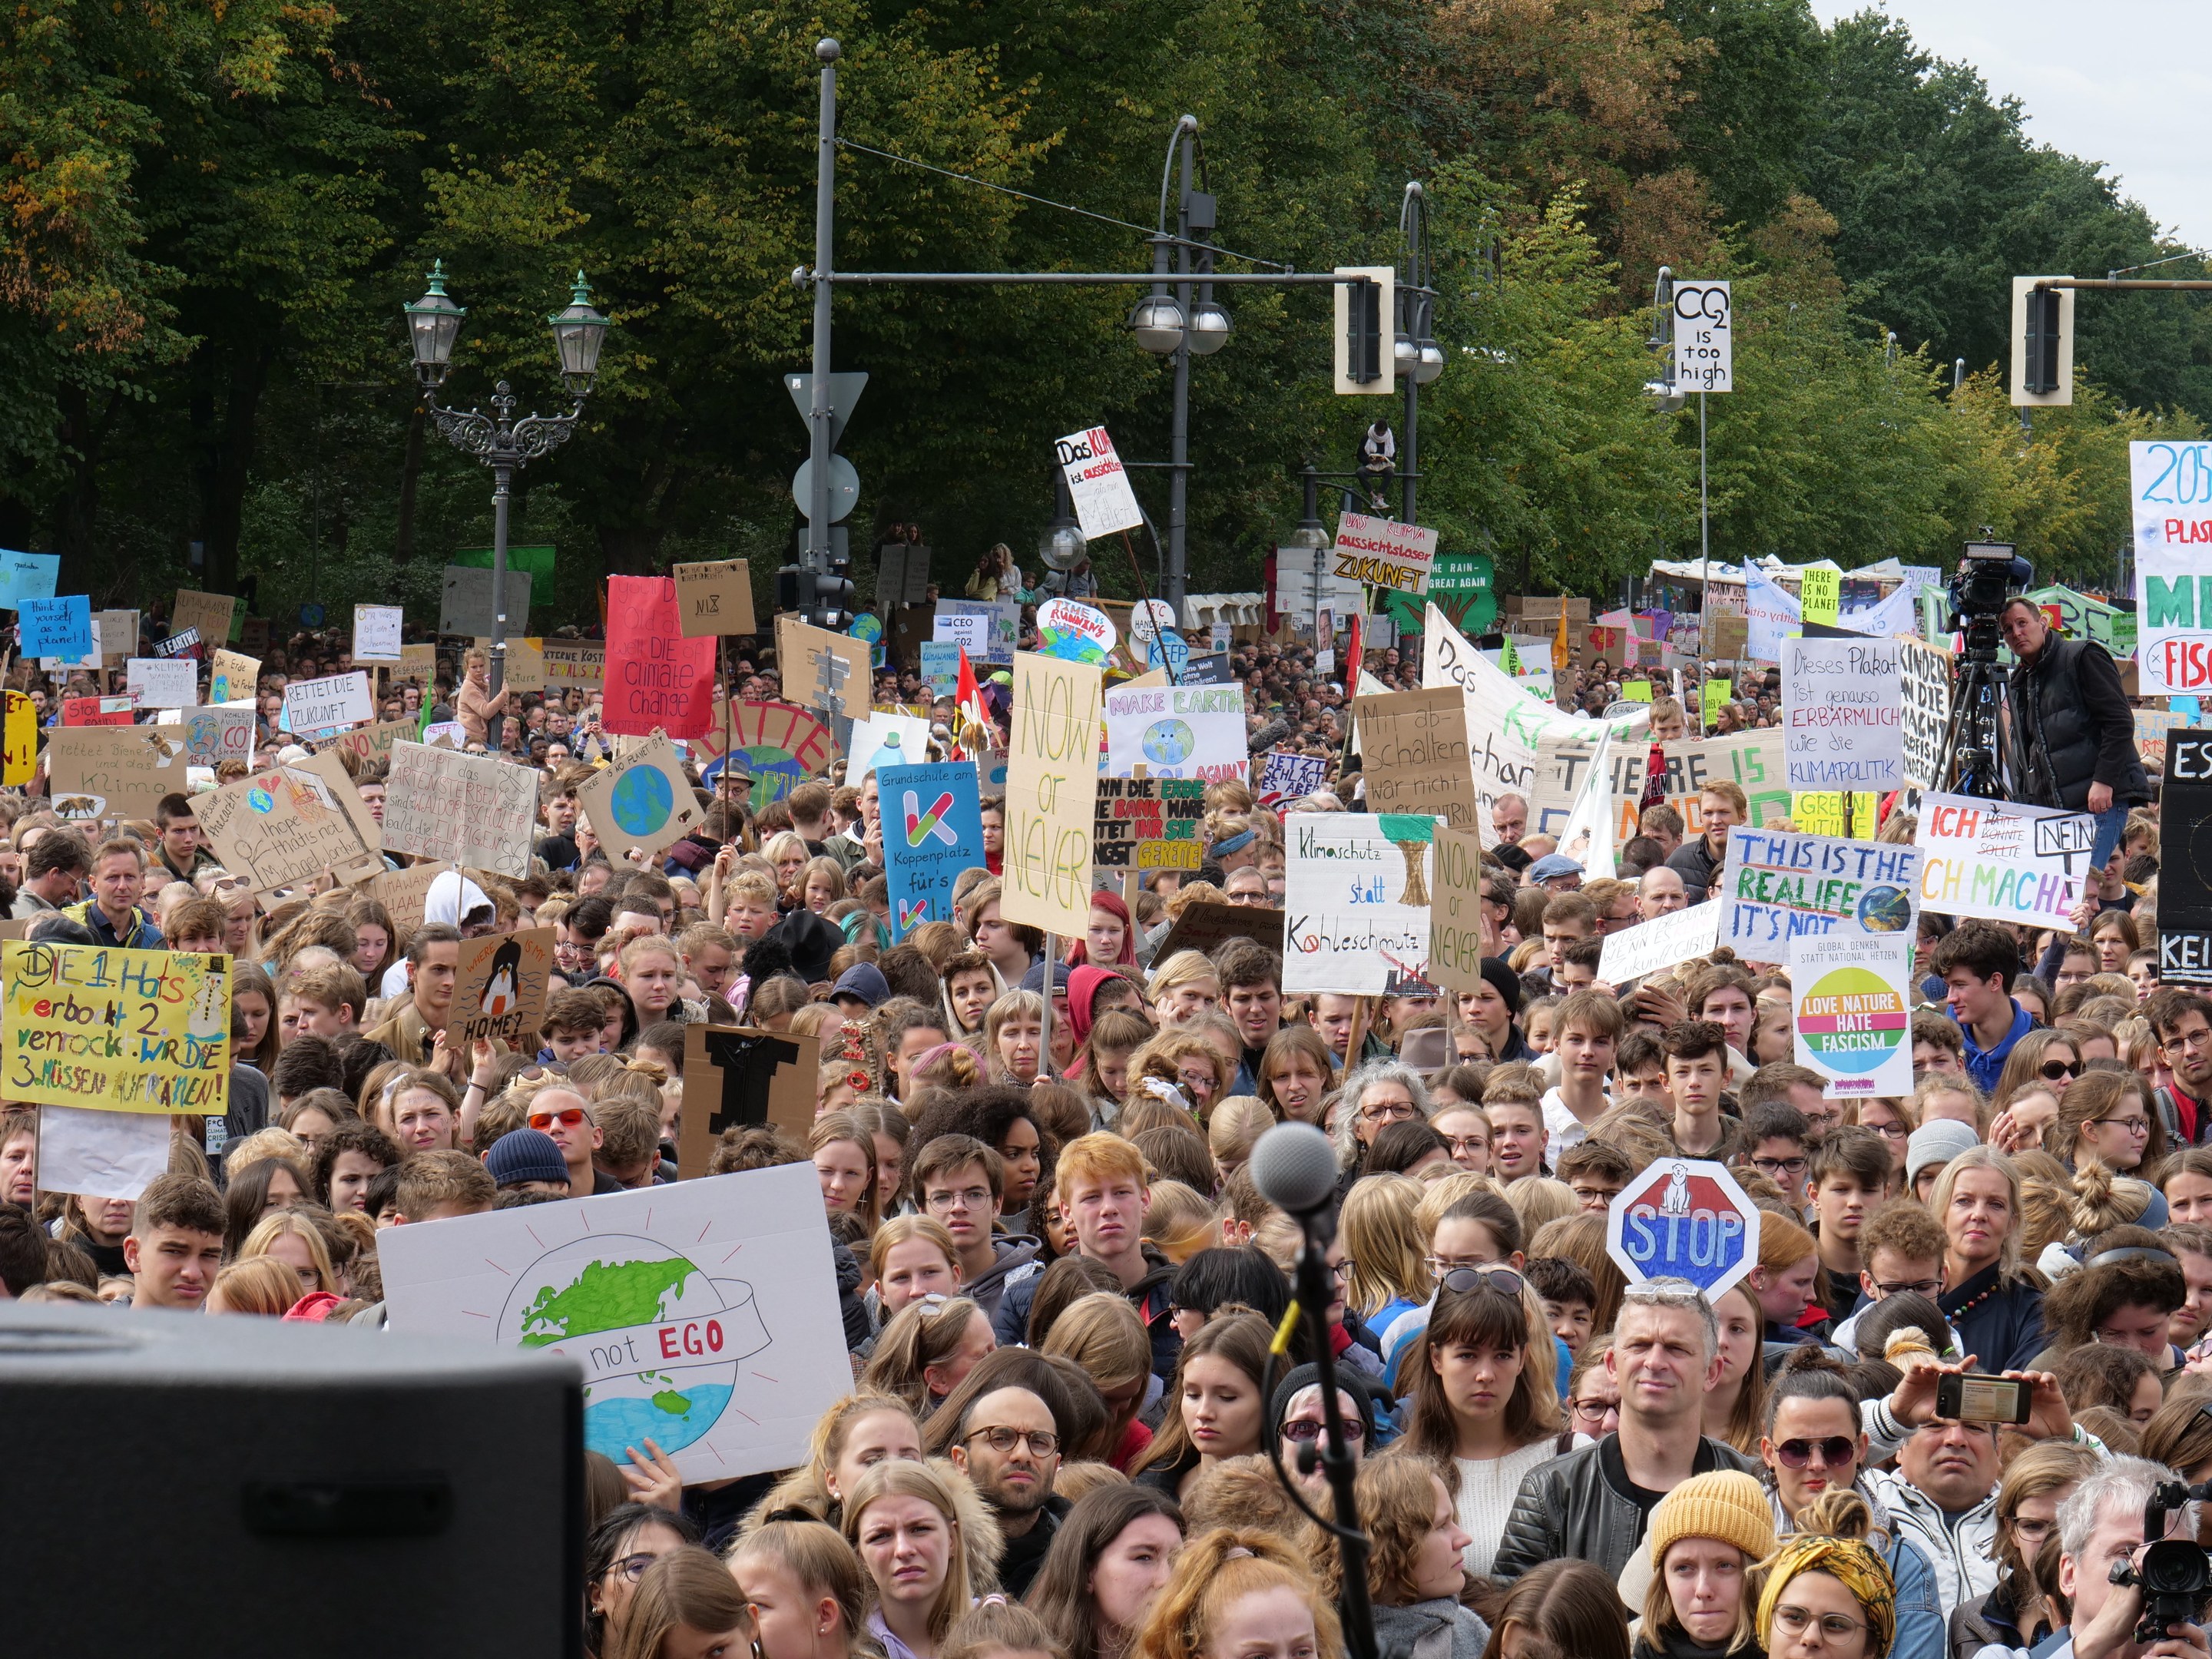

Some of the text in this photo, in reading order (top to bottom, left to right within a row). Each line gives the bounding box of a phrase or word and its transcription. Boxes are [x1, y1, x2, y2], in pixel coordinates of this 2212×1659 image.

[1697, 329, 1711, 343] is
[1684, 345, 1720, 359] too
[1681, 361, 1726, 391] high
[1071, 472, 1084, 485] ist
[1346, 512, 1426, 541] DAS KLIMA
[1336, 534, 1432, 562] aussichtsloser
[1333, 552, 1427, 594] ZUKUNFT
[1450, 562, 1479, 573] RAIN-
[1804, 570, 1832, 583] THERE
[1429, 577, 1486, 588] GREAT AGAIN
[1804, 584, 1828, 597] IS NO
[32, 600, 68, 613] think of
[1052, 600, 1104, 624] TIME is
[1802, 611, 1807, 621] B
[1803, 597, 1836, 611] PLANET
[33, 611, 74, 627] yourself
[953, 618, 973, 628] CEO
[155, 644, 167, 657] THE
[167, 633, 193, 654] EARTH
[544, 650, 577, 661] XTERNE
[651, 636, 704, 664] DIE of
[922, 651, 959, 661] KLIMAWANDEL
[216, 654, 246, 673] Die Erde
[1197, 661, 1214, 671] Welt
[1438, 636, 1476, 693] Das
[1793, 646, 1897, 677] Dieses Plakat
[231, 678, 240, 690] hat
[625, 662, 694, 690] Climate
[1183, 672, 1200, 680] ohne
[287, 677, 355, 704] RETTET DIE
[1110, 690, 1246, 716] MAKE EARTH
[1792, 679, 1880, 709] ist genauso
[1917, 681, 1945, 717] DIE
[70, 703, 98, 717] Stop
[292, 702, 347, 727] ZUKUNFT
[631, 690, 690, 717] Change
[428, 724, 458, 734] RETTET
[1022, 670, 1098, 765] NOW
[1363, 702, 1401, 737] Mit
[1792, 706, 1900, 727] ERBÄRMLICH
[2151, 716, 2180, 729] THE
[61, 743, 155, 760] rettet Bienen
[345, 733, 369, 757] NO
[368, 724, 419, 751] WEALTH
[1790, 730, 1853, 752] wie die
[96, 760, 152, 771] und das
[397, 746, 456, 773] STOPPT
[459, 760, 479, 781] das
[583, 777, 600, 793] THERE
[606, 770, 614, 778] IS
[616, 762, 624, 773] NO
[628, 746, 651, 765] PLANET
[1267, 753, 1326, 773] JETZT
[1730, 747, 1766, 785] IS
[1790, 758, 1898, 783] KLIMAPOLITIK
[81, 771, 167, 795] Klima
[389, 767, 531, 814] ARTENSTERBEN sonst
[882, 769, 973, 787] Grundschule am
[1128, 780, 1207, 800] DIE ERDE
[1261, 777, 1320, 796] ES ABER
[1371, 773, 1460, 800] war nicht
[389, 795, 410, 810] sind
[1038, 773, 1066, 815] or
[1114, 799, 1163, 819] BANK
[319, 820, 344, 841] not
[386, 810, 502, 852] bald die EINZIGEN
[1134, 819, 1197, 840] IHR SIE
[1930, 805, 1981, 839] ICH
[385, 834, 466, 861] in SEKTEN
[1299, 826, 1382, 860] Klimaschutz
[2043, 820, 2094, 852] NEIN
[321, 838, 361, 866] Jordan
[894, 846, 972, 869] Koppenplatz
[1005, 810, 1089, 912] NEVER
[1137, 841, 1204, 869] GERETTET
[1735, 833, 1916, 885] THIS IS THE
[1980, 843, 2021, 859] SOLLTE
[1437, 838, 1480, 895] NOW
[909, 869, 949, 894] für's
[1349, 874, 1386, 904] statt
[1971, 864, 2080, 917] MACHE
[1449, 896, 1463, 919] or
[1656, 902, 1715, 932] BILDUNG
[1286, 913, 1419, 954] Kohleschmutz
[1733, 903, 1782, 942] IT'S
[466, 939, 546, 972] WHERE IS MY
[1429, 922, 1480, 976] NEVER
[1603, 928, 1672, 963] WENN ES
[1674, 930, 1715, 959] GIBT?
[1800, 950, 1898, 964] STATT NATIONAL HETZEN
[1817, 940, 1879, 952] GLOBAL DENKEN
[19, 994, 127, 1029] verbockt
[1805, 993, 1895, 1015] LOVE NATURE
[463, 1011, 524, 1041] HOME?
[1836, 1013, 1873, 1032] HATE
[1822, 1032, 1886, 1054] FASCISM
[1628, 1204, 1743, 1267] STOP
[590, 1319, 724, 1370] not EGO
